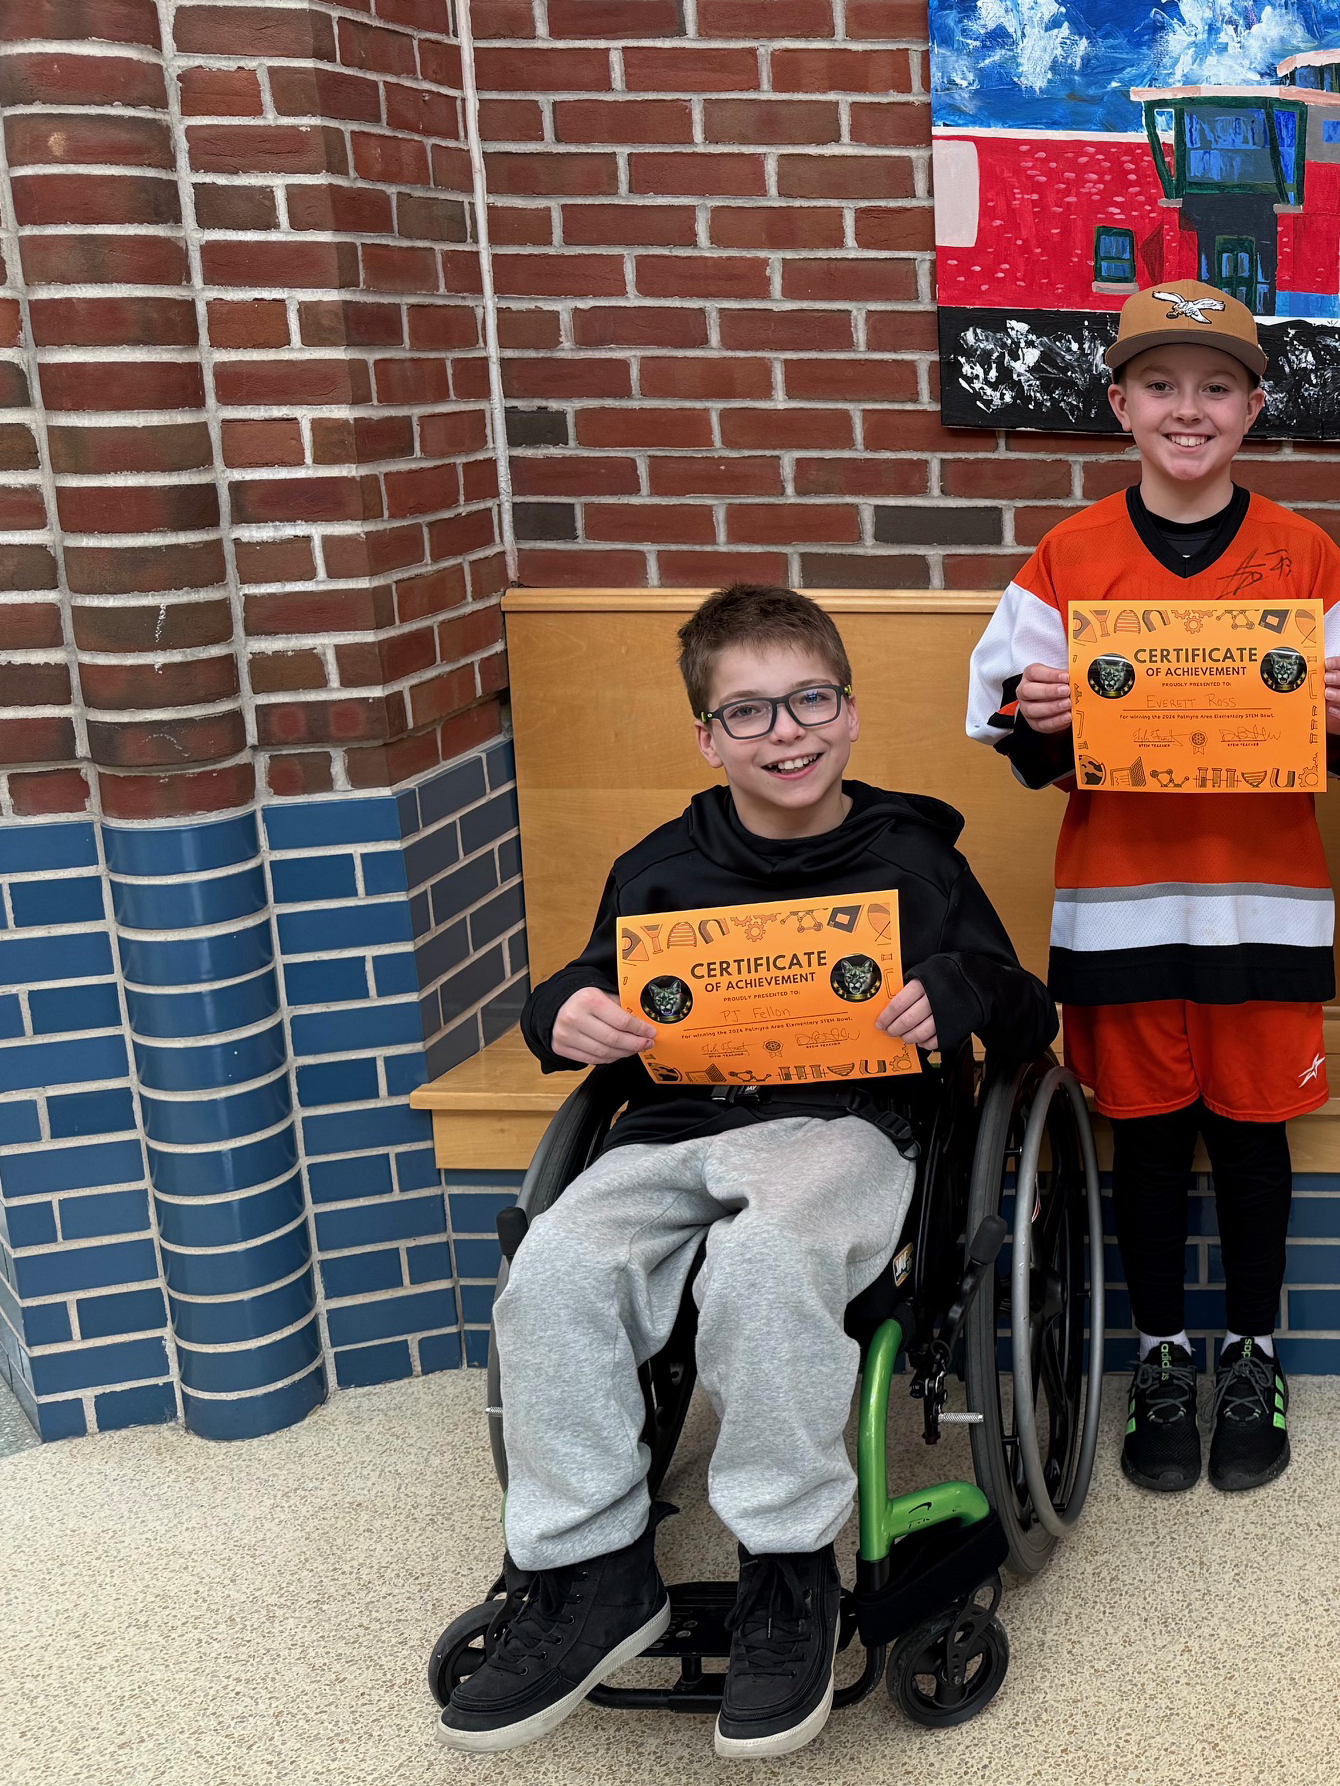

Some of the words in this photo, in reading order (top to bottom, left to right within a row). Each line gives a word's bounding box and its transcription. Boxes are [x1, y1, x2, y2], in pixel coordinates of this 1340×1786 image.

[1133, 647, 1258, 664] CERTIFICATE
[1146, 667, 1162, 677] OF
[1164, 666, 1248, 677] ACHIEVEMENT
[1146, 694, 1196, 709] EVERETT
[1206, 693, 1237, 708] ROSS
[690, 950, 828, 980] CERTIFICATE
[704, 982, 722, 993] OF
[726, 972, 816, 991] ACHIEVEMENT
[753, 991, 788, 1000] PRESENTED
